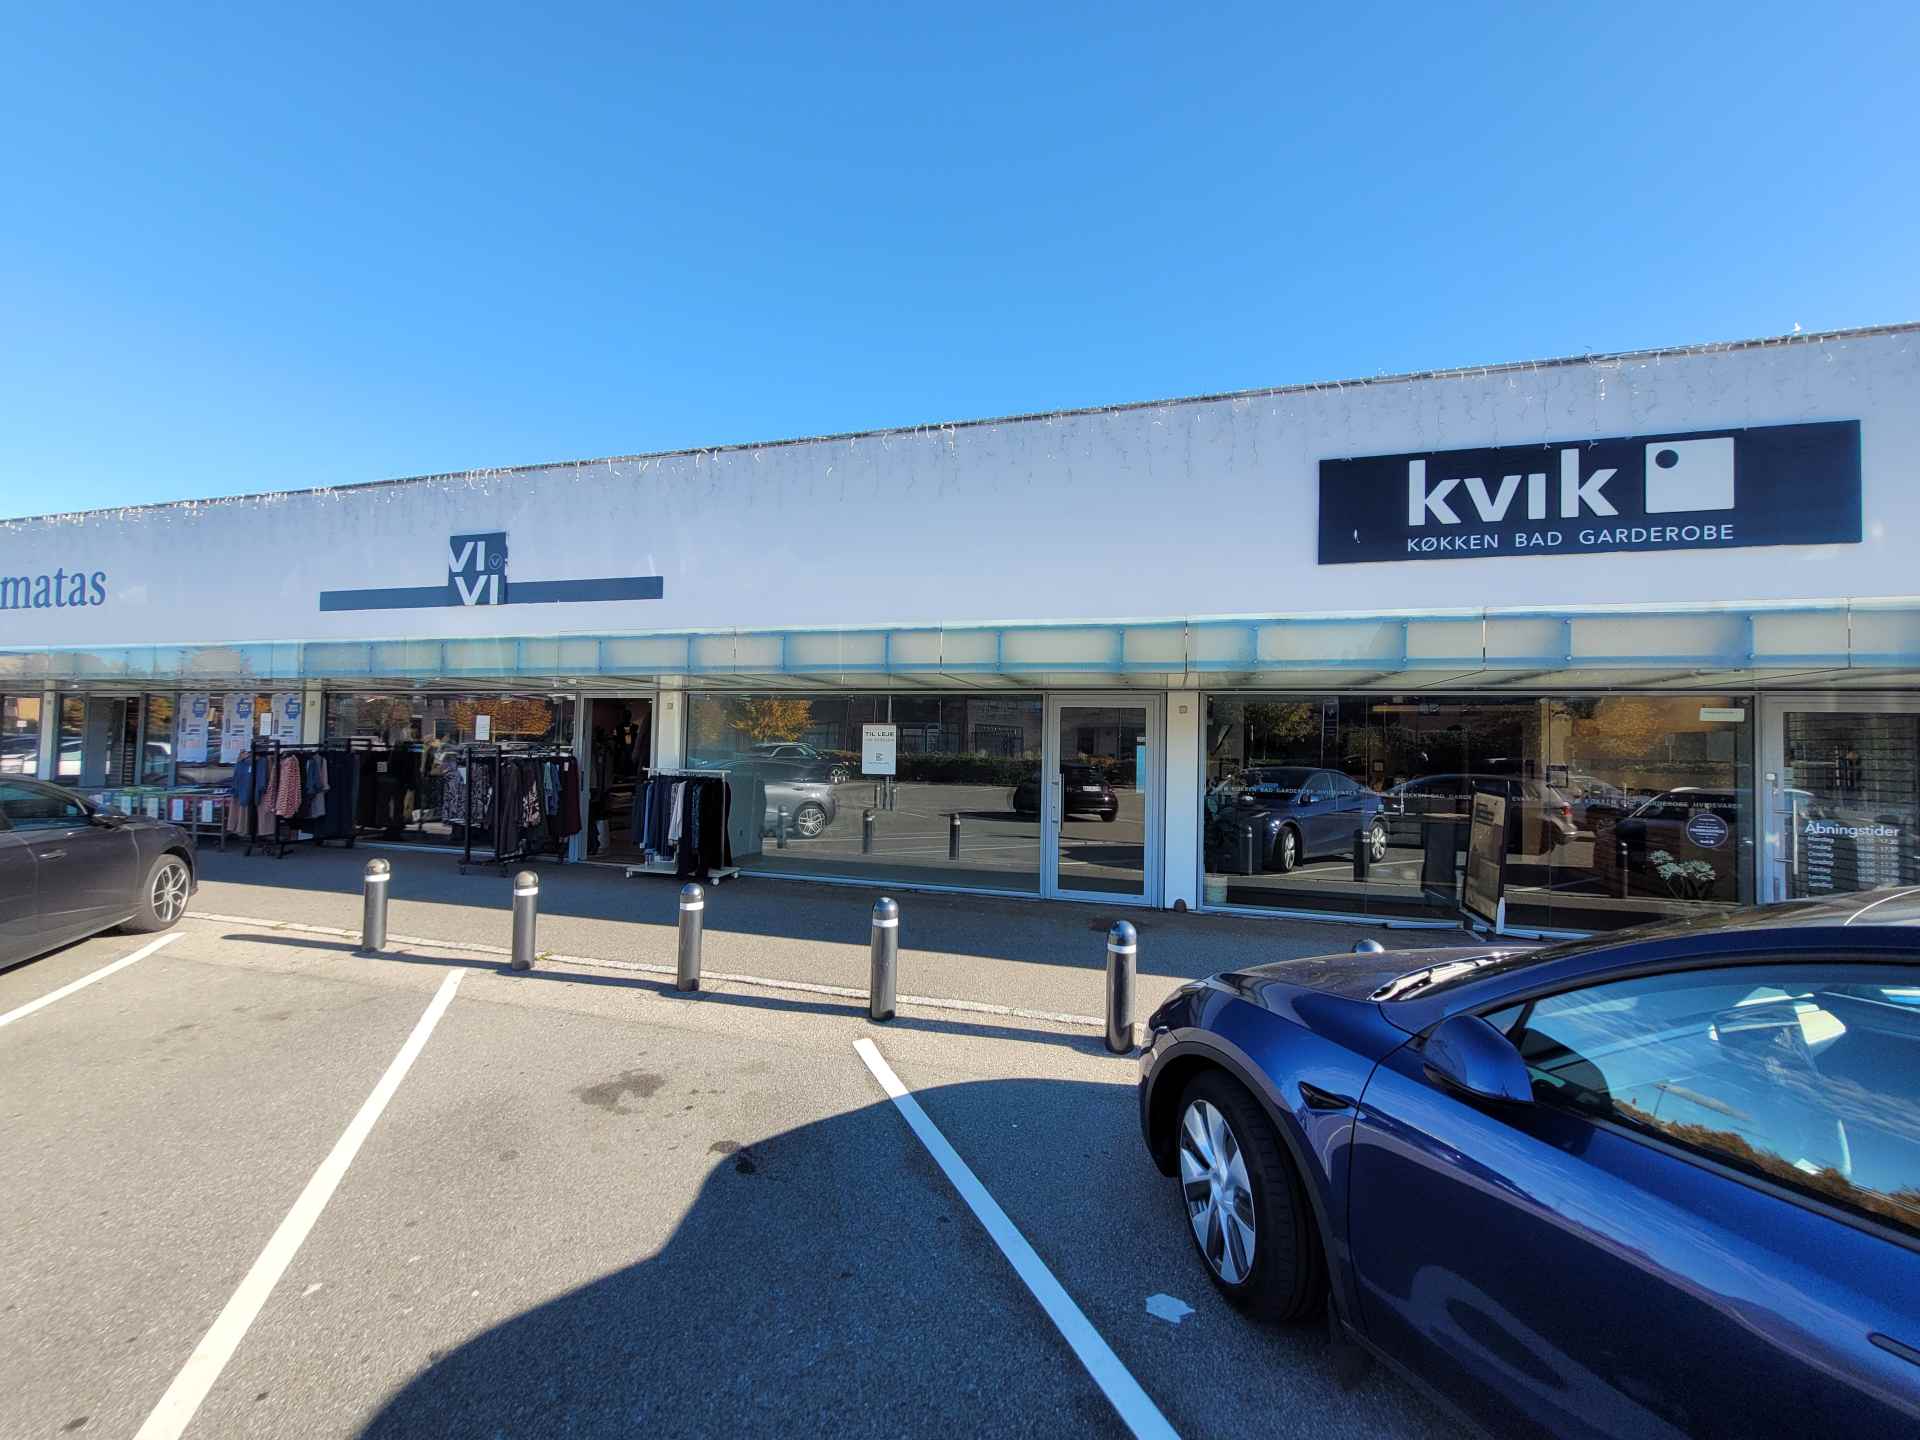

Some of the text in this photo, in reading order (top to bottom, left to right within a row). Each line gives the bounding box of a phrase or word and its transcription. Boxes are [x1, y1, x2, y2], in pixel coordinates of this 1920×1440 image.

[1408, 448, 1620, 526] kvik
[1407, 524, 1735, 553] KØKKEN BAD GARDEROBE
[449, 541, 486, 572] VI
[0, 568, 107, 609] matas
[454, 574, 499, 606] VI
[1804, 820, 1900, 838] Åbningstider
